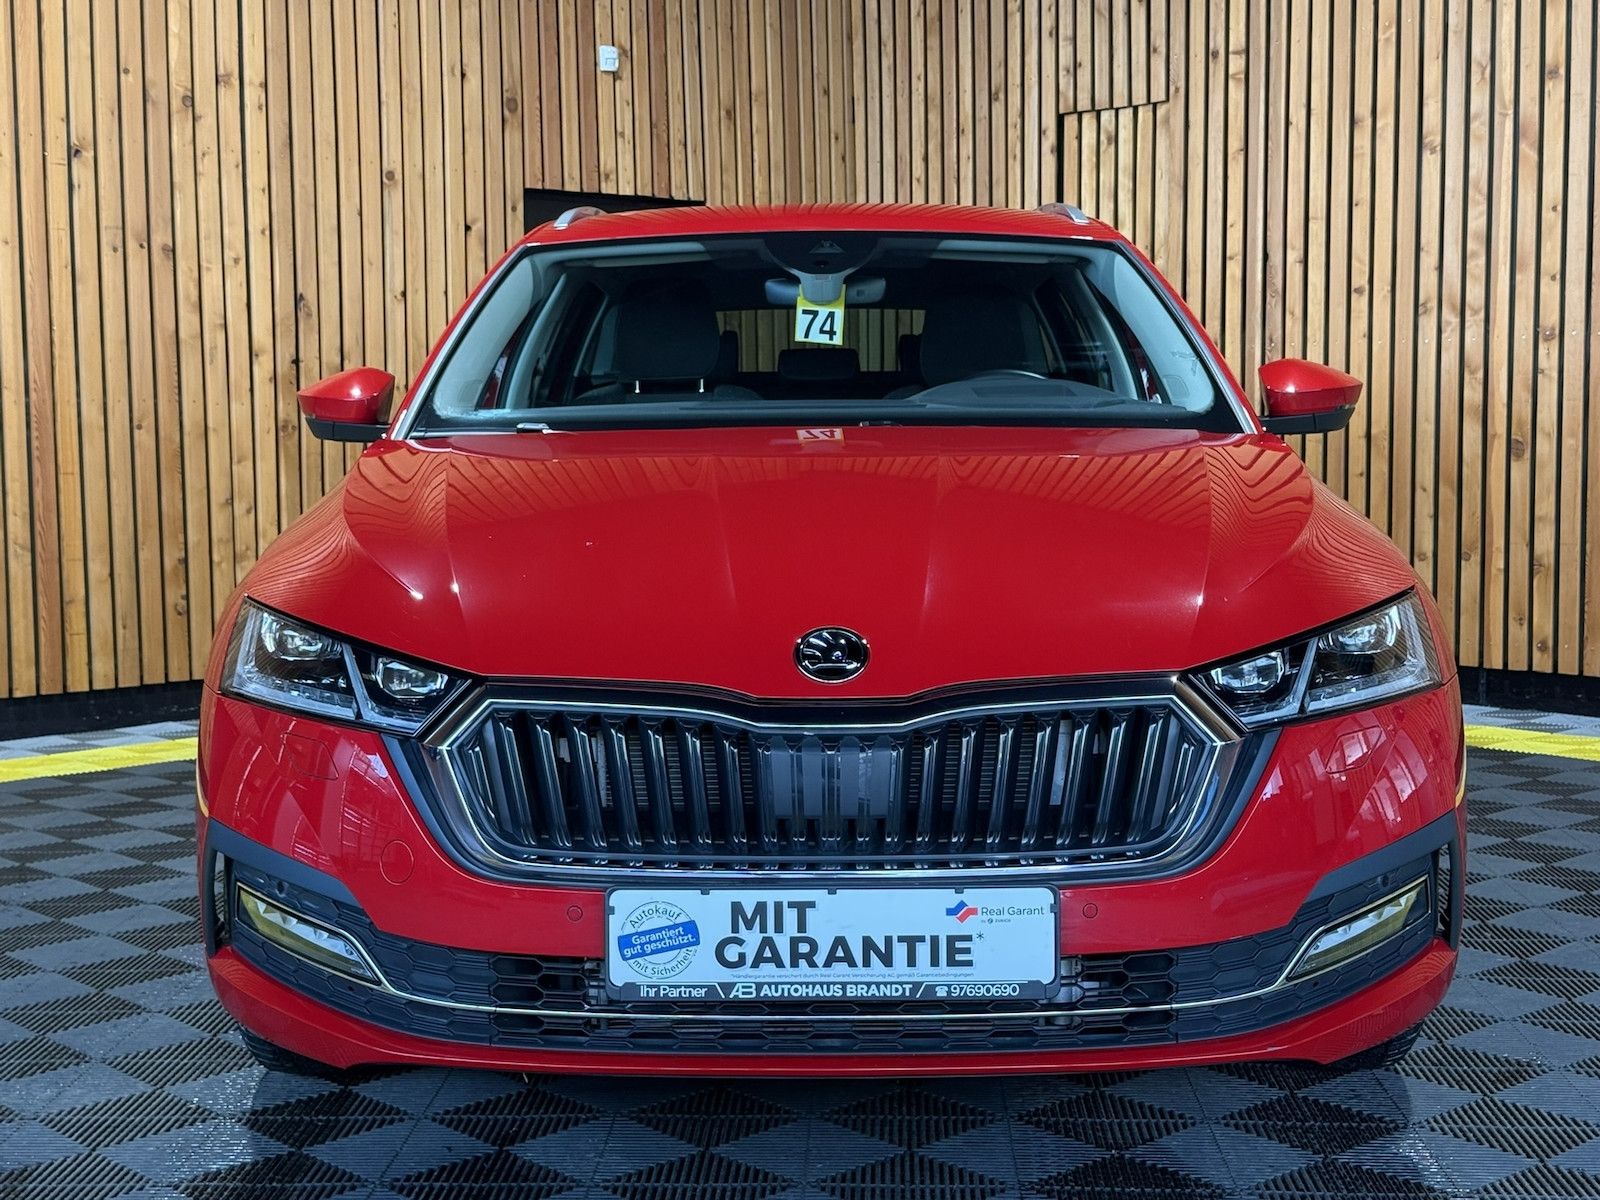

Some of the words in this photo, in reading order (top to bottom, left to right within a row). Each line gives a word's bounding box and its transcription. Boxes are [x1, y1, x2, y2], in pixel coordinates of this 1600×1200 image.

[801, 309, 837, 341] 74
[629, 905, 682, 929] Autokauf
[730, 901, 816, 934] MIT
[981, 906, 1005, 916] Real
[1007, 906, 1045, 916] Garant
[623, 945, 643, 958] gut
[643, 934, 697, 954] geschützt.
[631, 926, 685, 945] Garantiert
[632, 960, 649, 973] mit
[650, 947, 693, 976] Sicherheit
[640, 985, 657, 998] Ihr
[659, 985, 708, 998] Partner
[760, 984, 843, 997] AUTOHAUS
[846, 983, 913, 997] BRANDT
[950, 983, 1020, 997] 97690690
